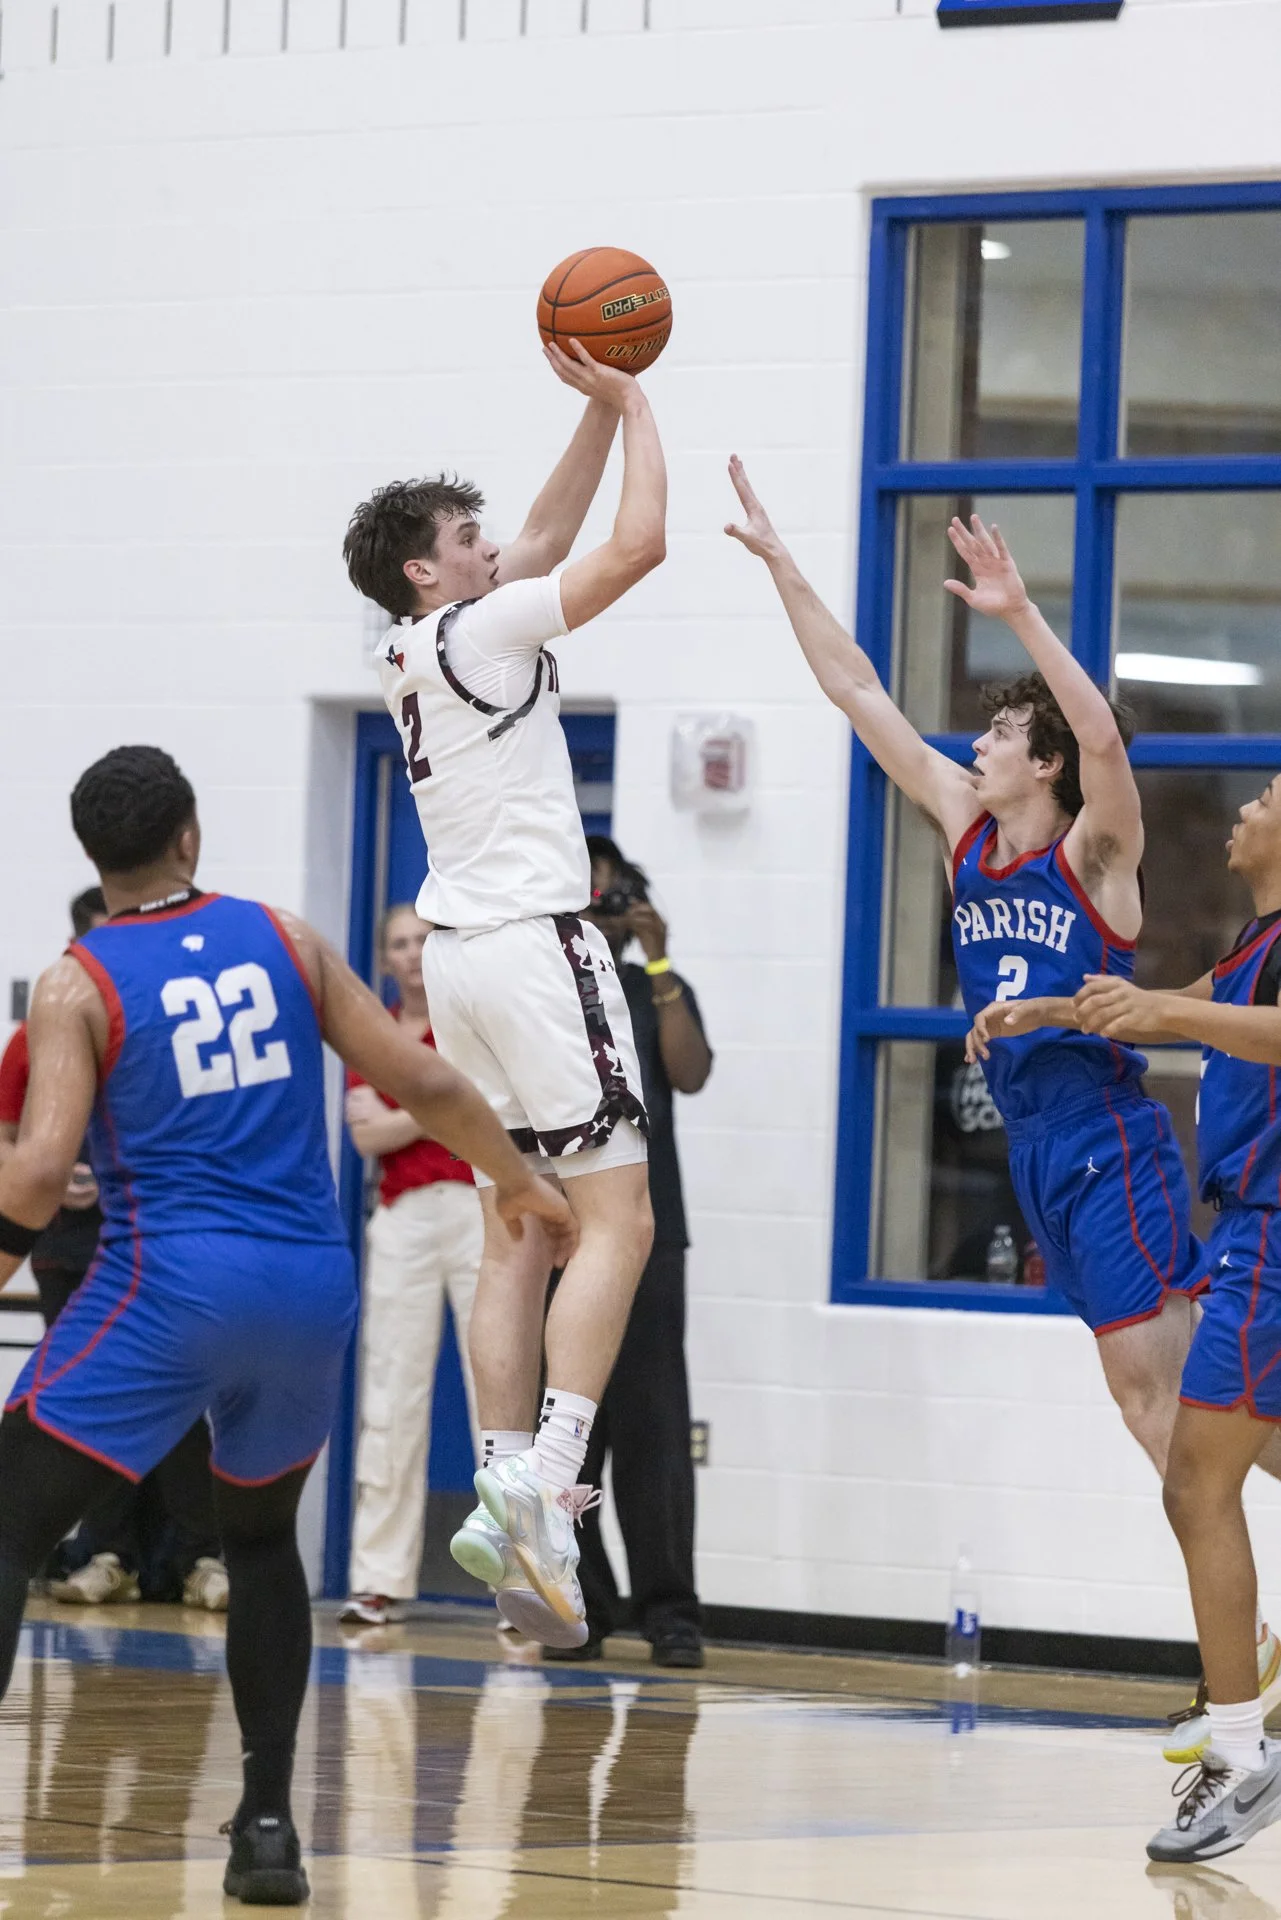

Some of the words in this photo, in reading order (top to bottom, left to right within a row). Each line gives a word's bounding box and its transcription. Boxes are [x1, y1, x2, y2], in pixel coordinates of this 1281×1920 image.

[601, 297, 635, 321] PRO
[633, 285, 669, 309] ELITE
[401, 691, 432, 784] 2
[954, 898, 1077, 953] PARISH
[995, 955, 1029, 1002] 2
[160, 962, 292, 1099] 22
